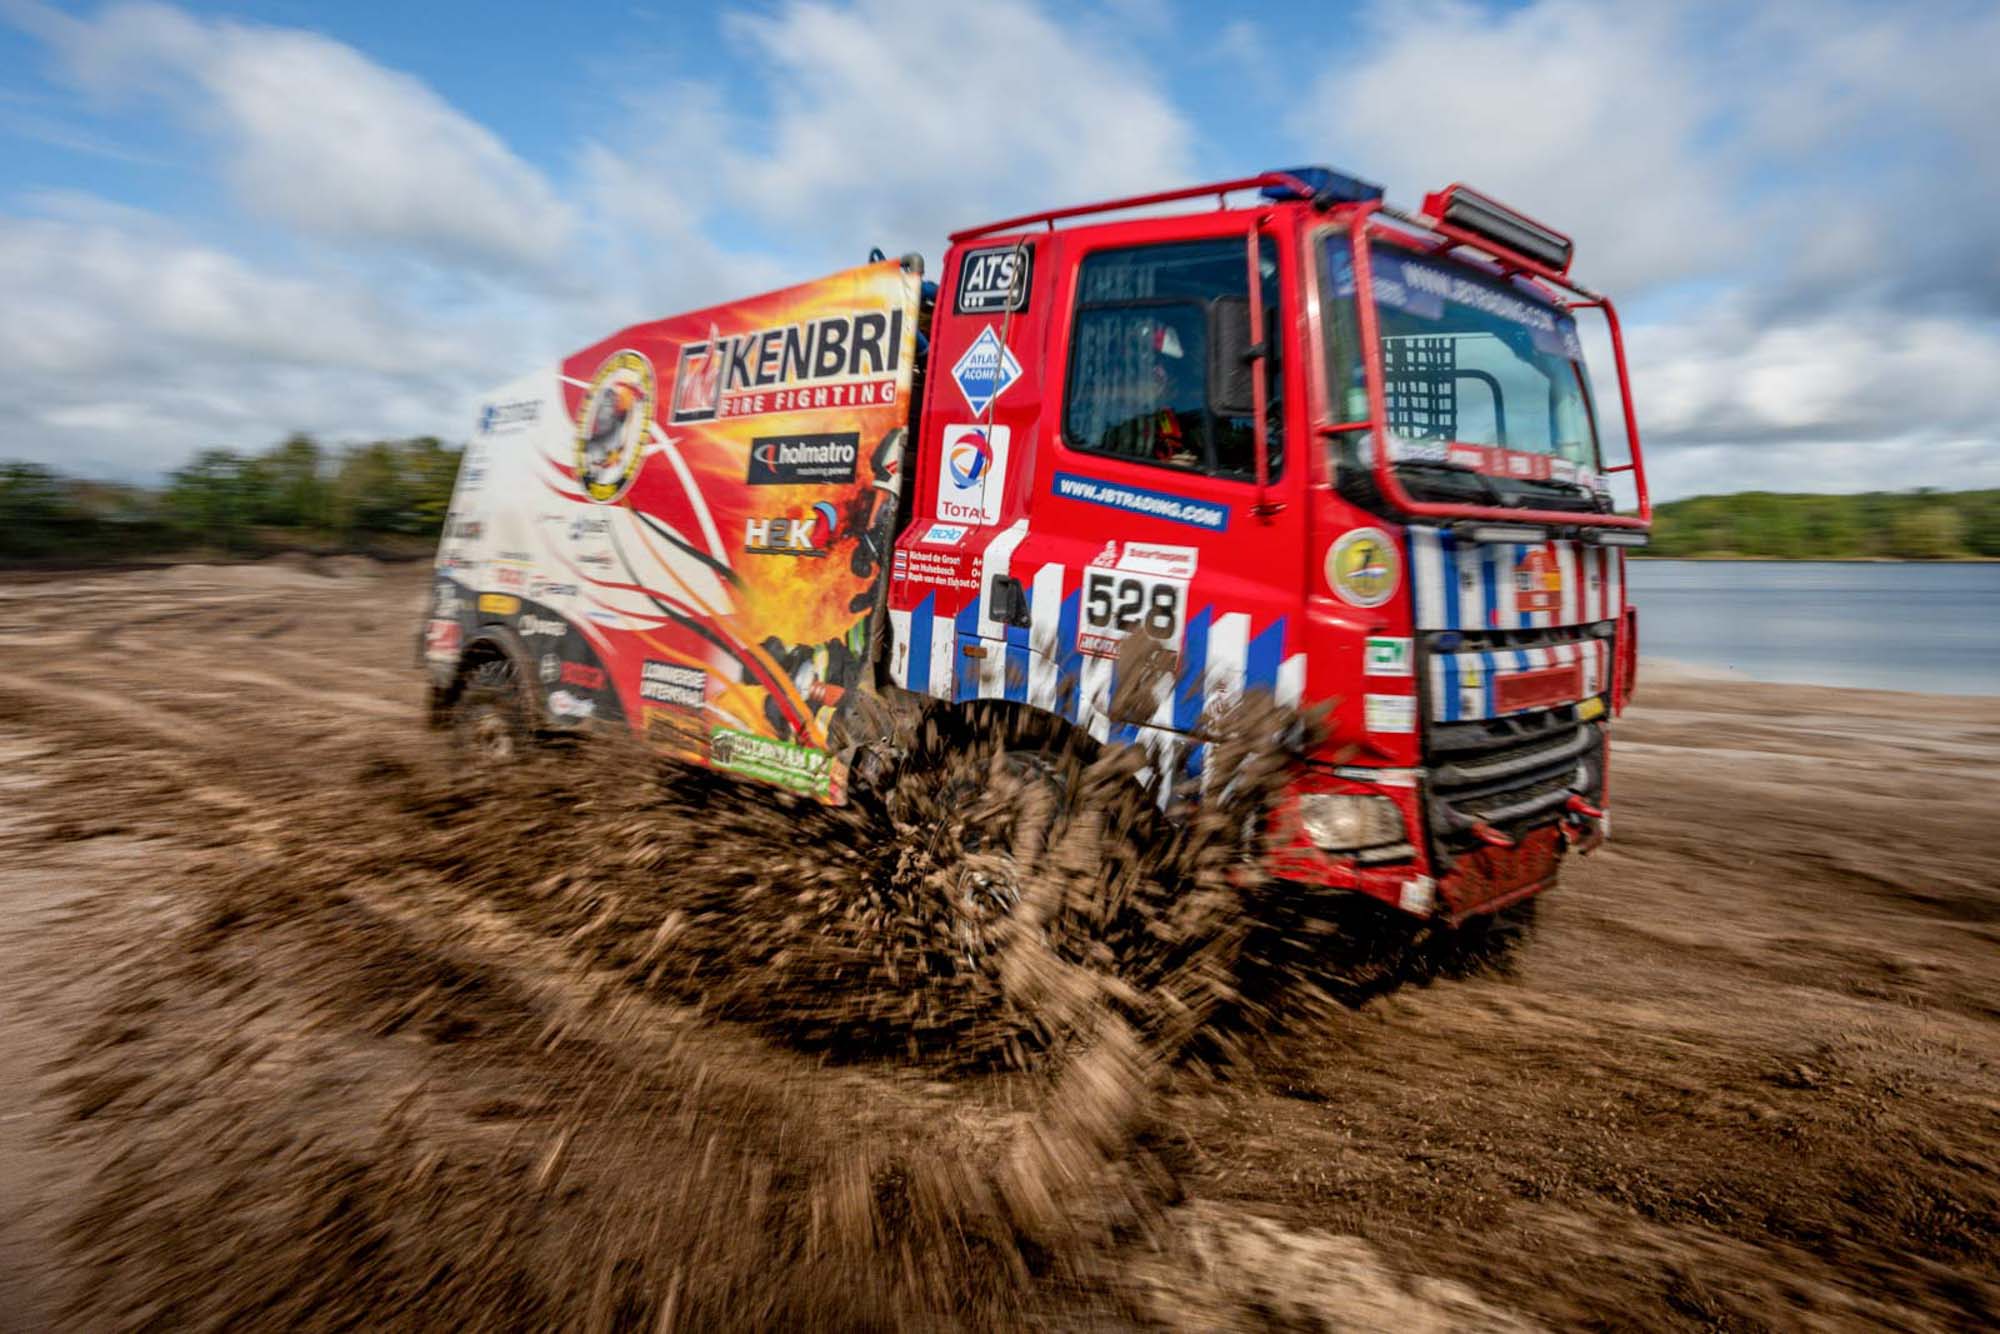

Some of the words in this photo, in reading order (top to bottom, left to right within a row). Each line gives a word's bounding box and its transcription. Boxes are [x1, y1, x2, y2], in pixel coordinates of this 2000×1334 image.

[966, 253, 1022, 291] ATS
[726, 307, 903, 390] KENBRI
[720, 396, 764, 416] FIRE
[776, 382, 896, 411] FIGHTING
[779, 442, 855, 464] holmatro
[1060, 479, 1223, 527] WWW.JBTRADING.COM
[745, 518, 816, 549] H2K
[909, 550, 932, 562] Richard
[933, 554, 941, 562] de
[1086, 573, 1178, 640] 528
